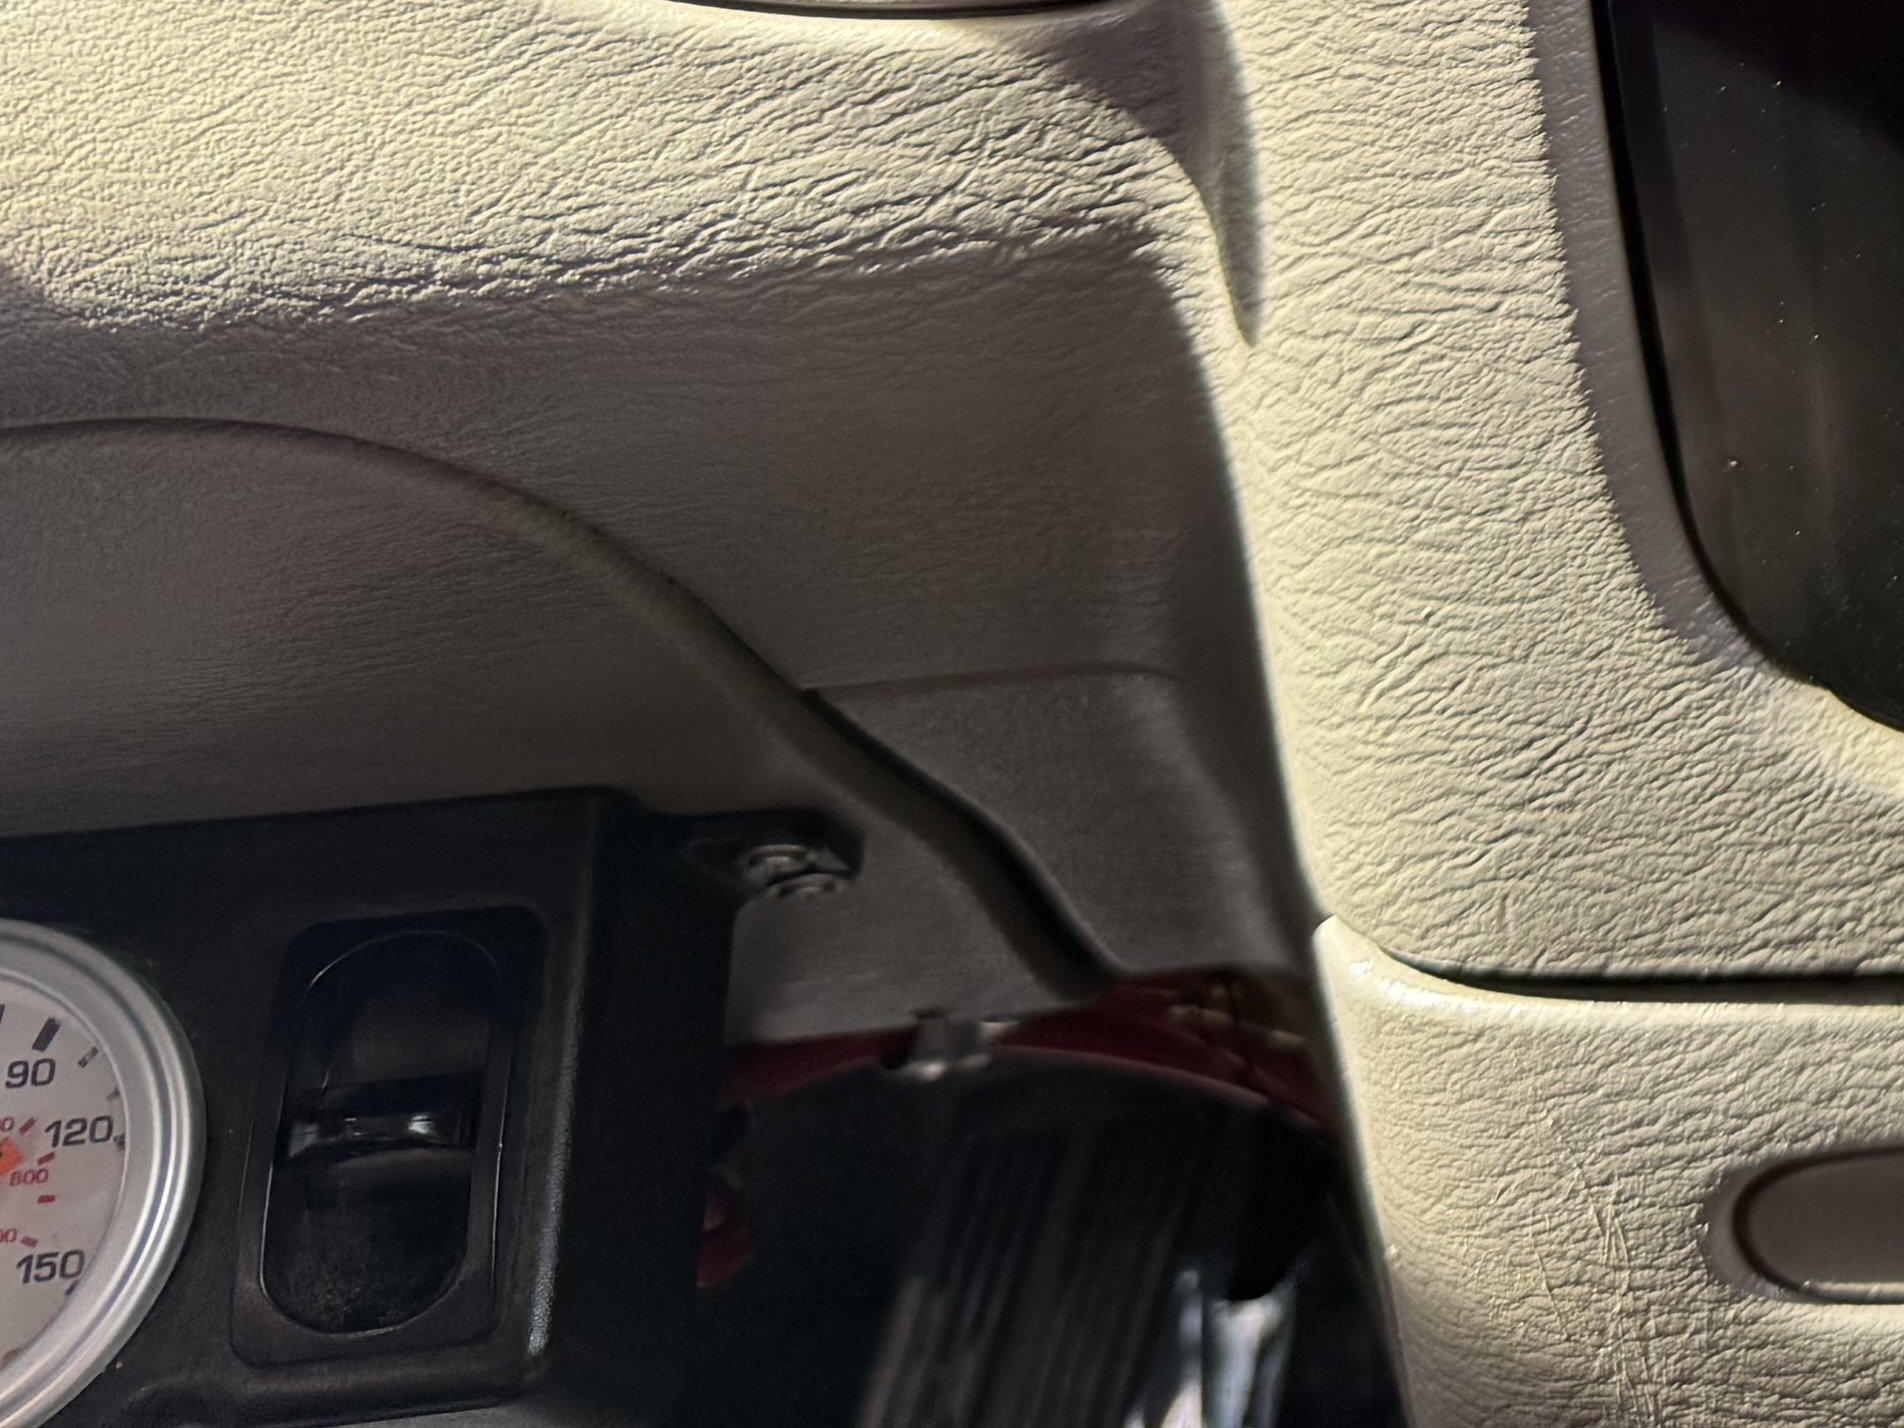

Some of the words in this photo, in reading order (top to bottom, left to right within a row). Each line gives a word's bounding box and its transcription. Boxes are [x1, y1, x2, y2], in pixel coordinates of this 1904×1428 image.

[5, 1058, 56, 1089] 90
[45, 1115, 113, 1147] 120
[16, 1249, 85, 1284] 150
